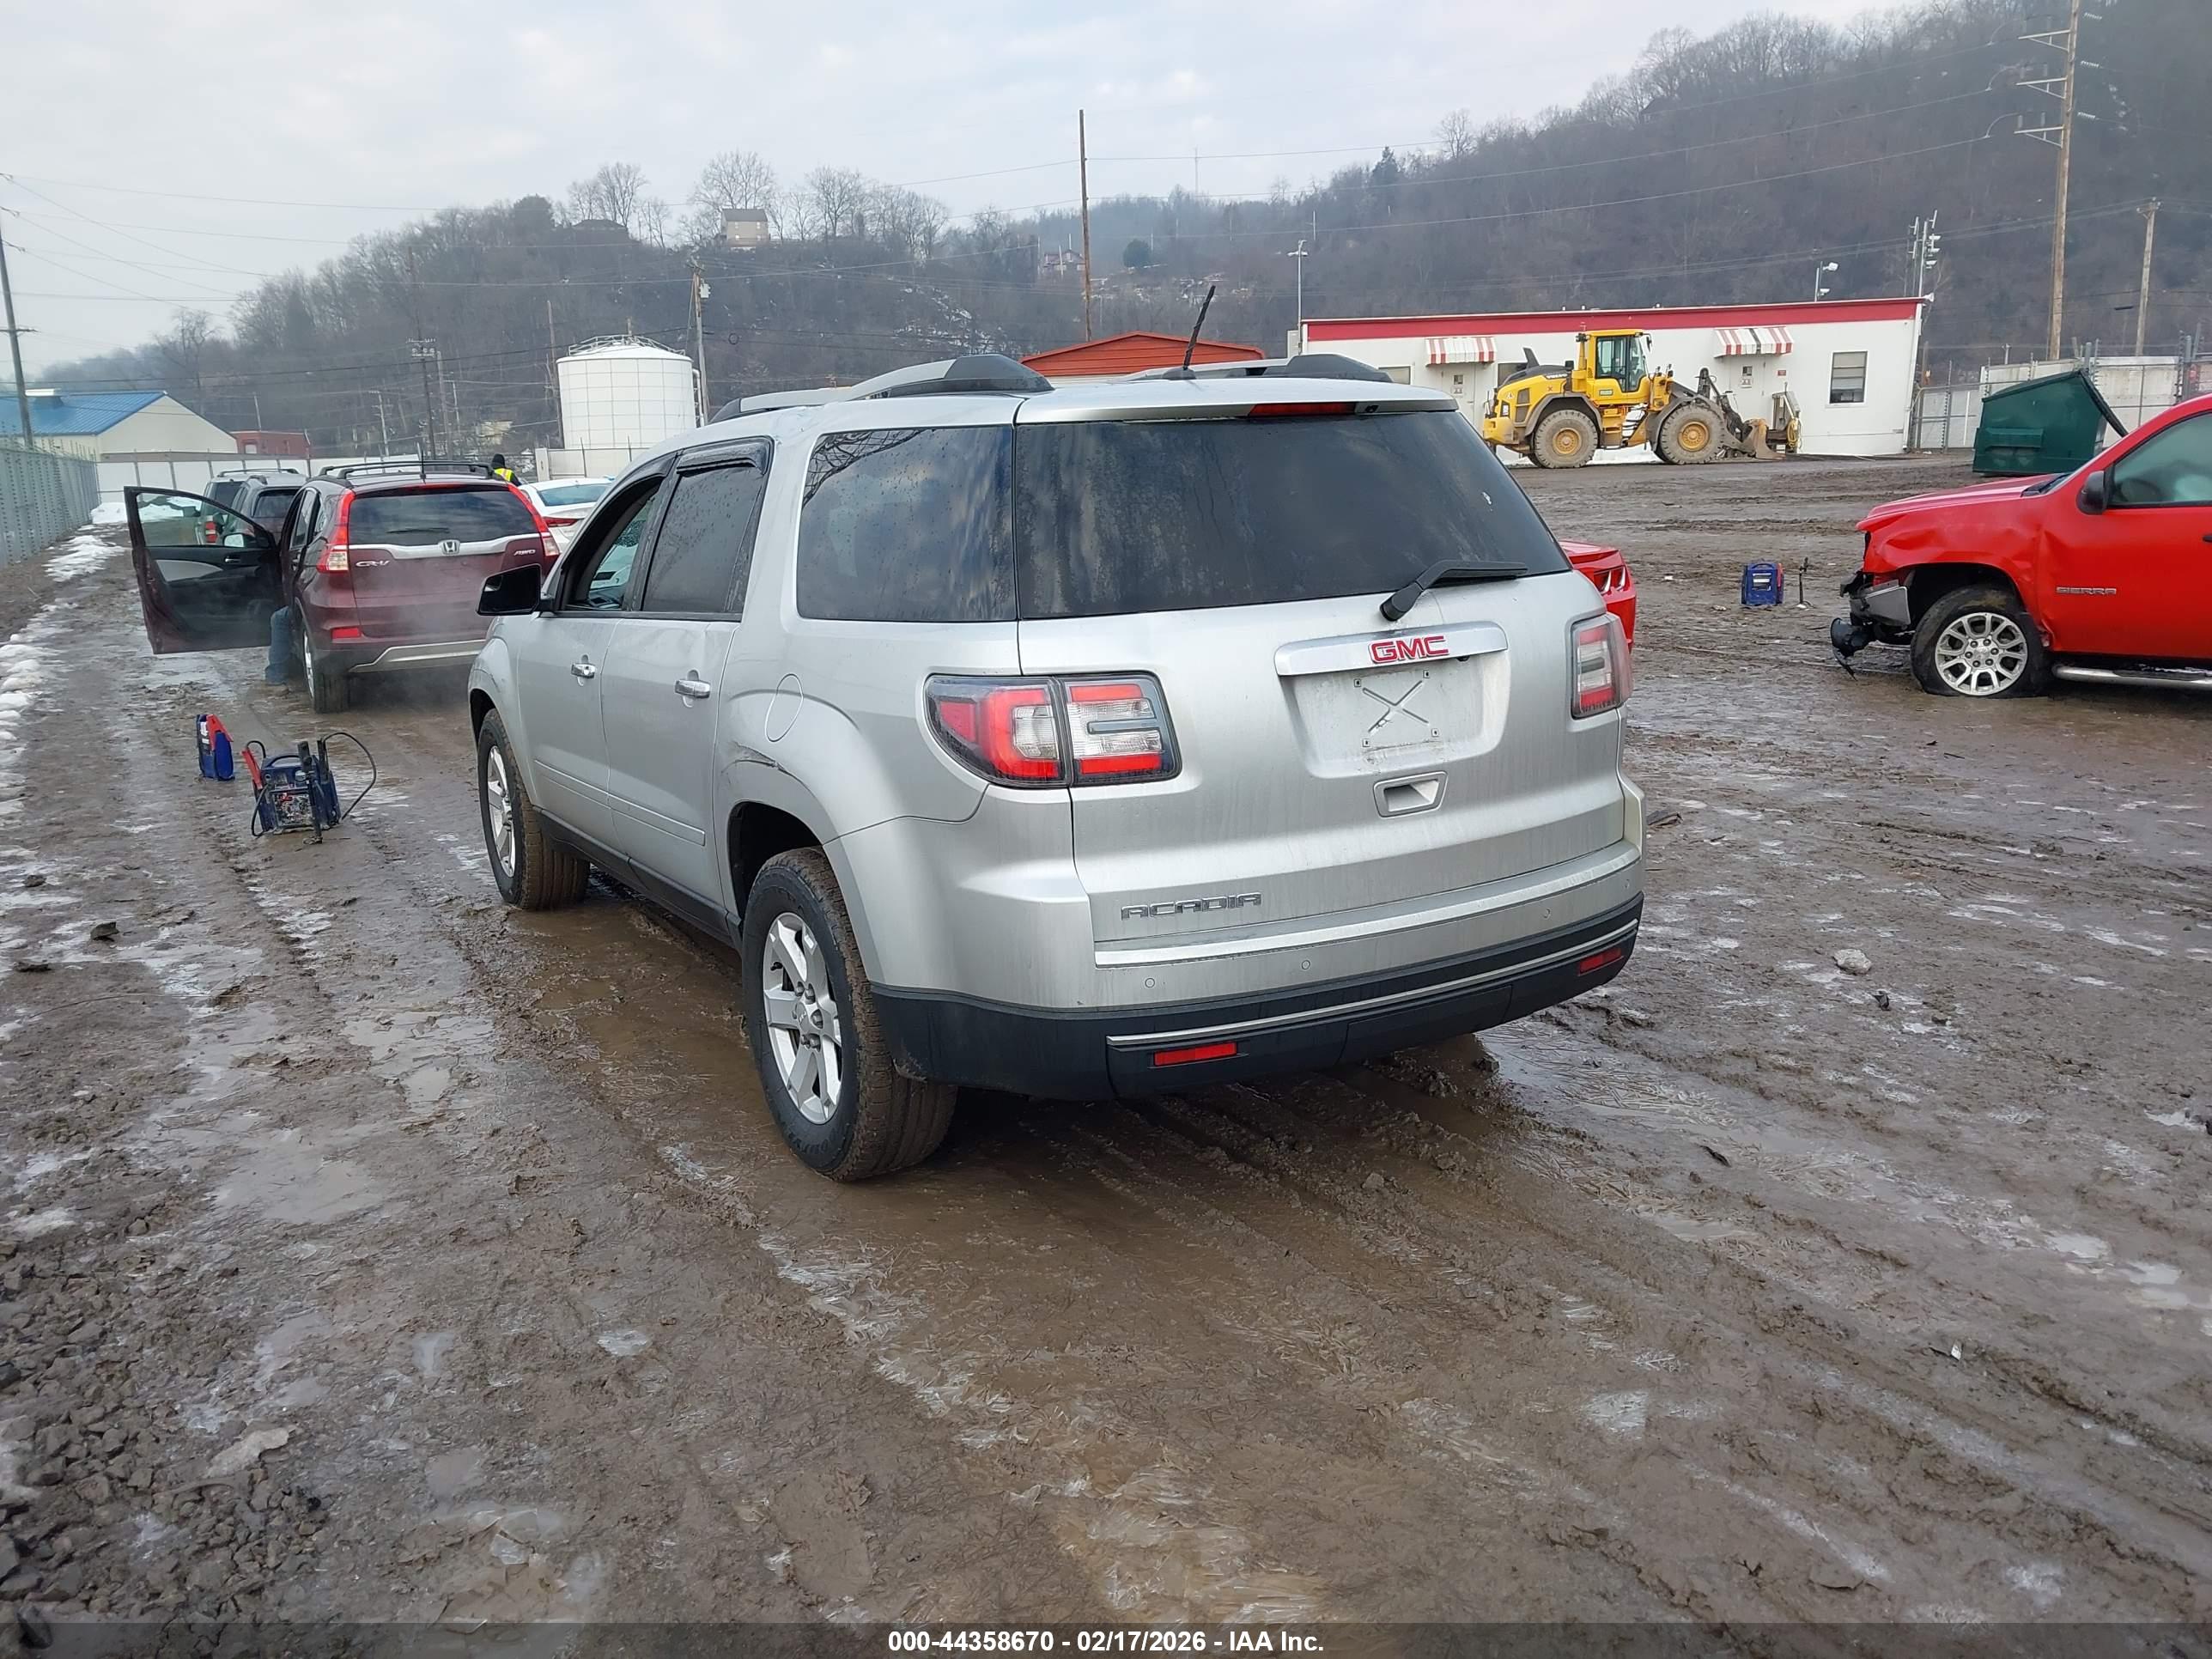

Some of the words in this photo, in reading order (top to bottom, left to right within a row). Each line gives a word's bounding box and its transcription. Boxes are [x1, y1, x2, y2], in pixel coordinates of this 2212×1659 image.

[2056, 586, 2117, 595] SIERRA
[1369, 634, 1449, 663] GMC
[1121, 891, 1262, 921] ACADIA
